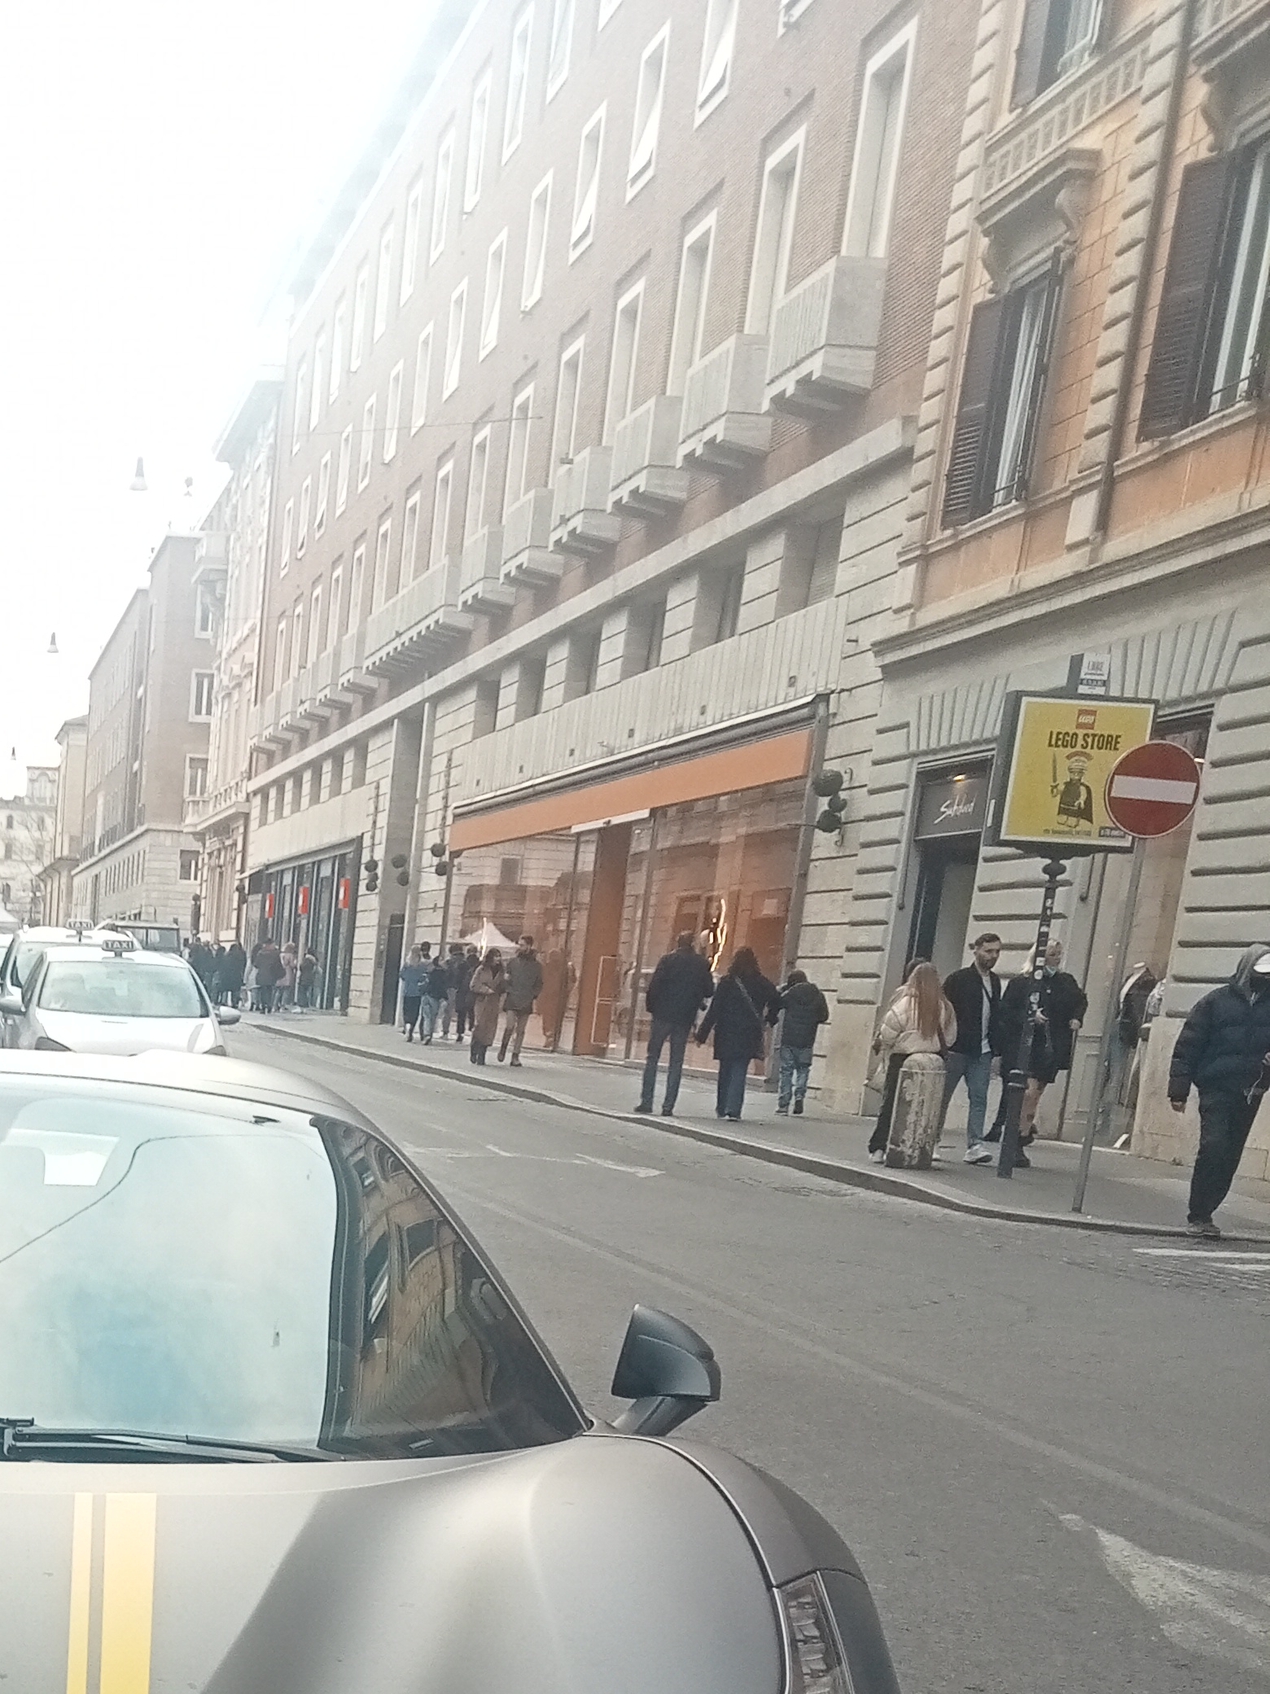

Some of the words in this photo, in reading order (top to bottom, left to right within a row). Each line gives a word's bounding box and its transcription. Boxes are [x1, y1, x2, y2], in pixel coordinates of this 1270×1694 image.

[1048, 730, 1079, 749] LEGO
[1081, 732, 1122, 751] STORE
[69, 921, 91, 929] TAXI
[106, 940, 133, 949] TAXI
